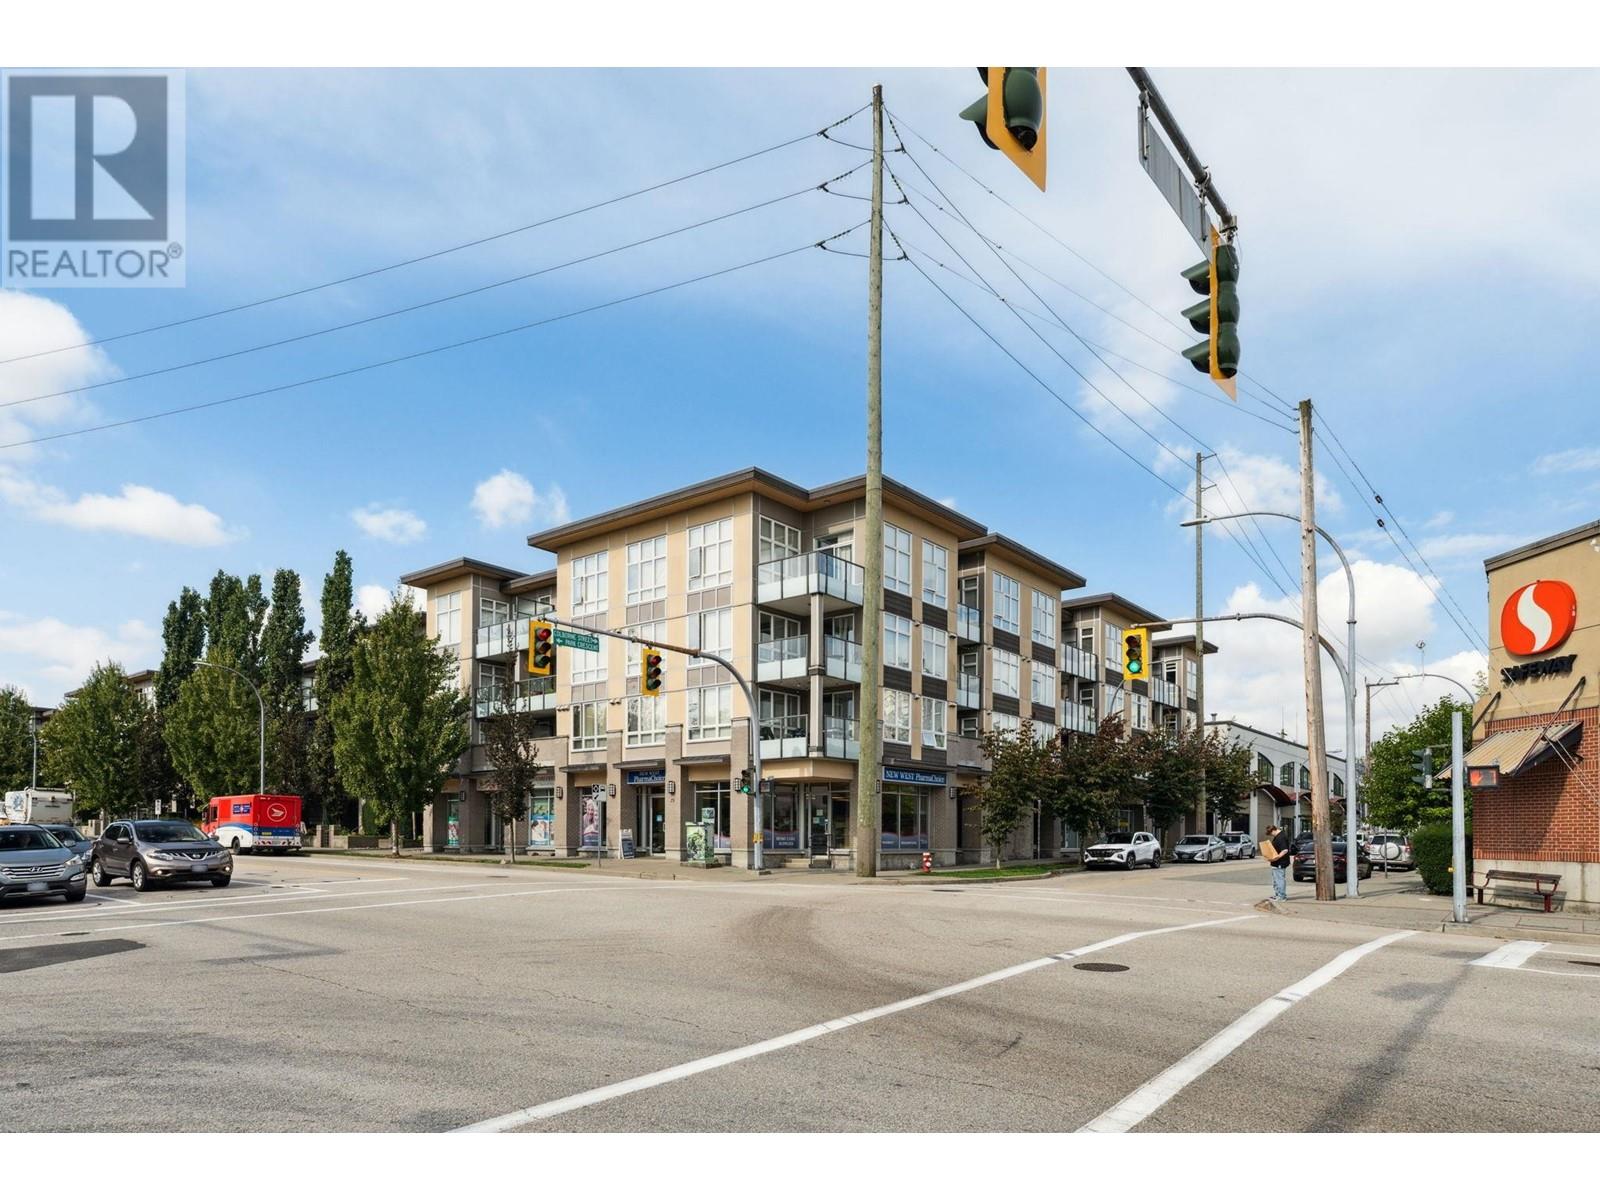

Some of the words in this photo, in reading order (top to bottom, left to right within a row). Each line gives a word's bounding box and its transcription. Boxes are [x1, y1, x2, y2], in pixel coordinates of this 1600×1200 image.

[577, 641, 598, 650] CRESCENT
[1501, 654, 1577, 683] SAFEWAY
[885, 769, 899, 779] NEW
[900, 771, 914, 780] WEST
